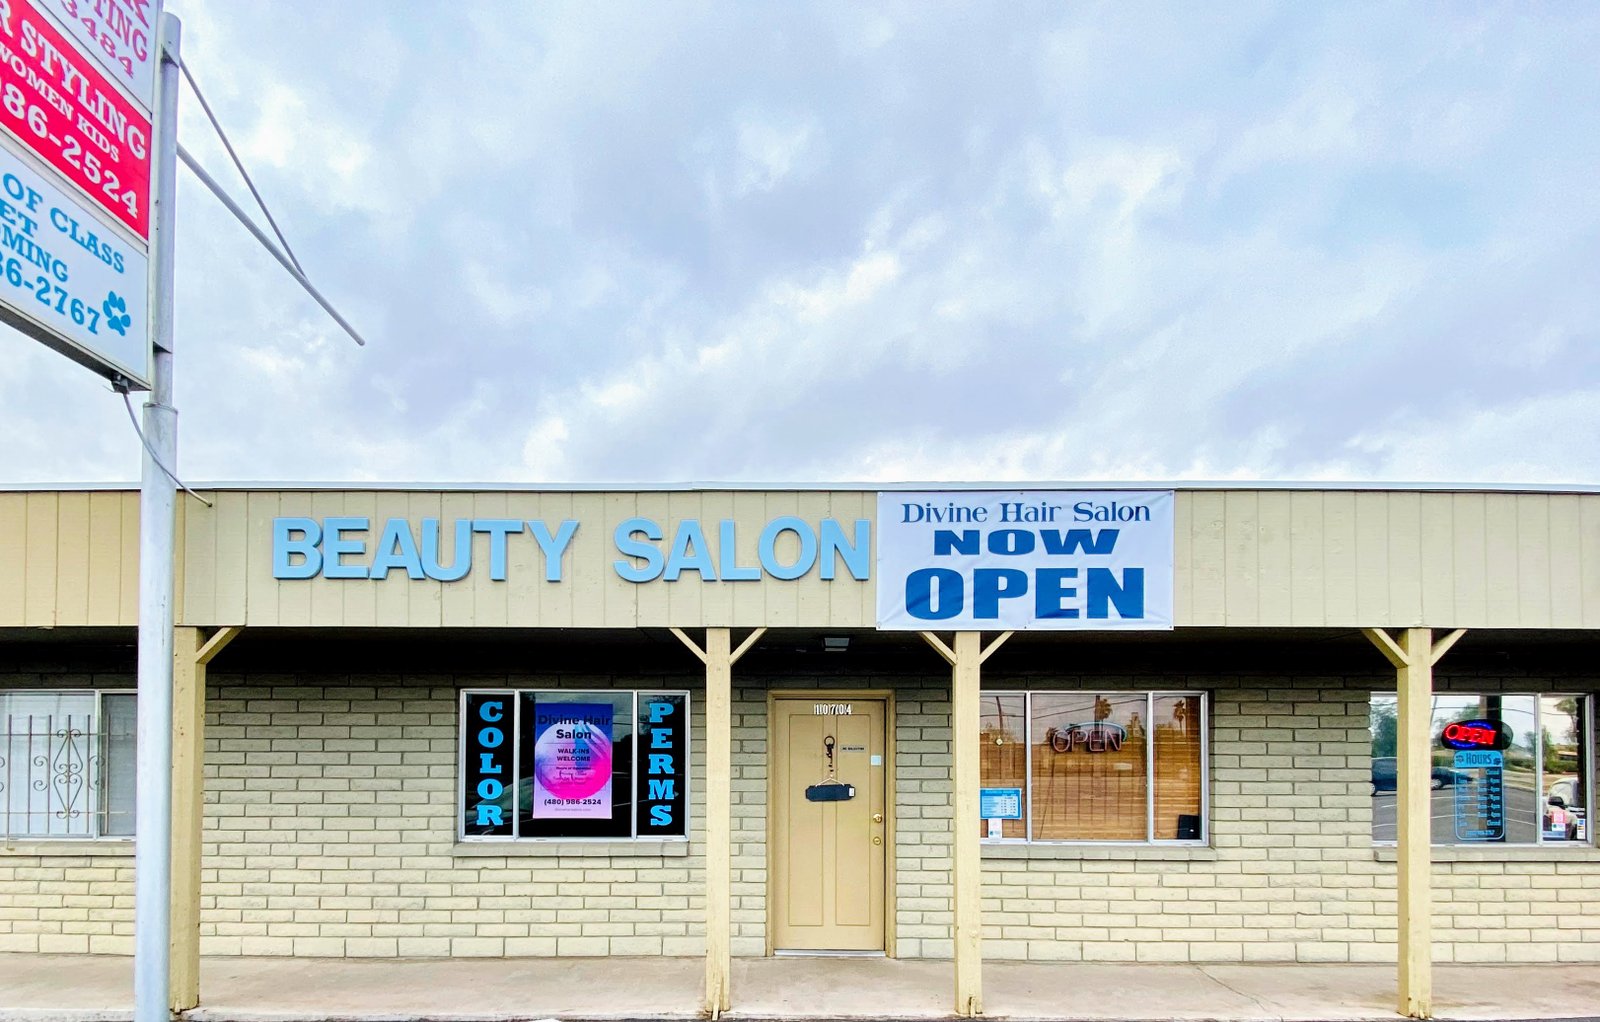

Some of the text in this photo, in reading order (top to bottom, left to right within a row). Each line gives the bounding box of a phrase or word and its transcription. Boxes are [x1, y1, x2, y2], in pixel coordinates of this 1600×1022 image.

[21, 19, 146, 160] STYLING
[0, 83, 138, 219] 86-2524
[77, 113, 119, 163] KIDS
[3, 173, 124, 274] OF CLASS
[0, 251, 100, 335] 6-2767
[901, 501, 1152, 524] Divine Hair Salon
[272, 516, 871, 583] BEAUTY SALON
[933, 528, 1120, 556] NOW
[905, 567, 1145, 620] OPEN
[538, 713, 611, 725] Divine Hair
[556, 729, 592, 740] Salon
[1053, 729, 1122, 753] OPEN
[1444, 723, 1497, 746] OPEN
[476, 701, 504, 826] COLOR
[648, 702, 675, 827] PERMS
